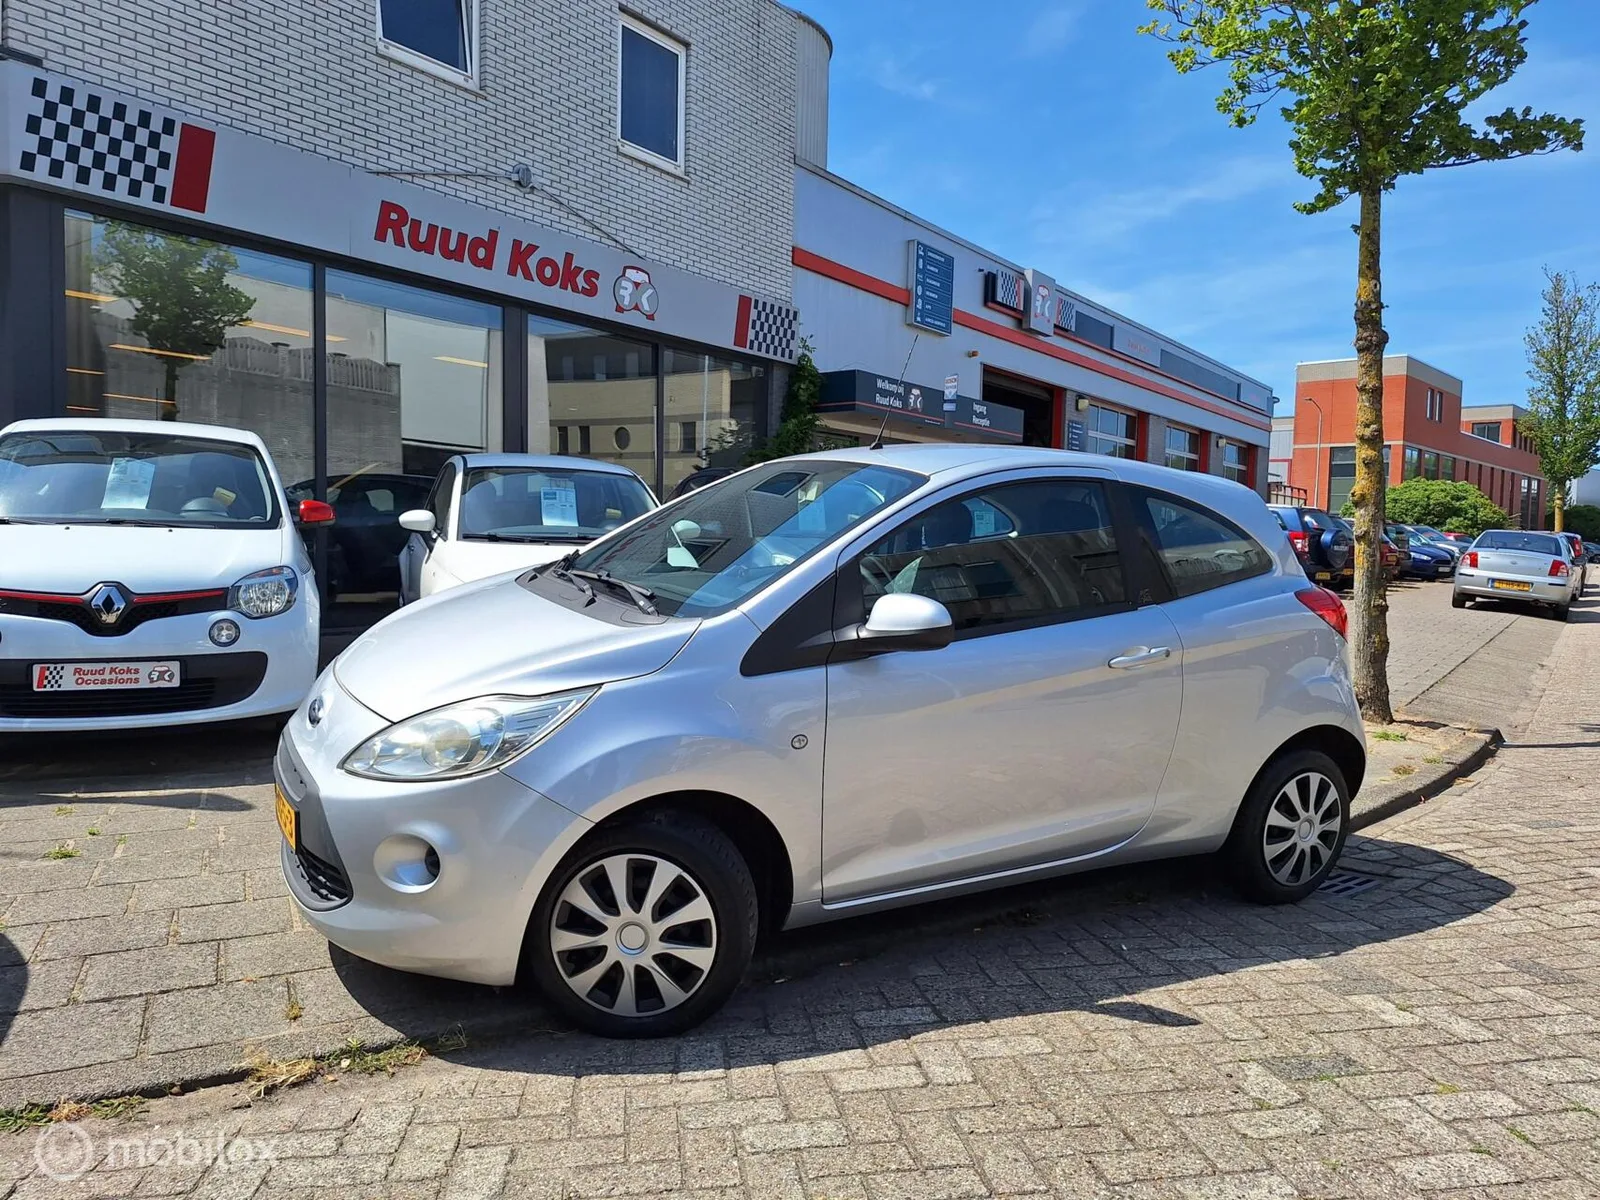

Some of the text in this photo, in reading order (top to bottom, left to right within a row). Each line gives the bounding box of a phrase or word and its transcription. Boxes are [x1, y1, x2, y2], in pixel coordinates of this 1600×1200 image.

[374, 199, 499, 270] Ruud
[507, 238, 601, 298] Koks
[875, 393, 903, 408] Ruud Koks
[73, 666, 140, 676] Ruud Koks
[75, 676, 140, 686] Occasions
